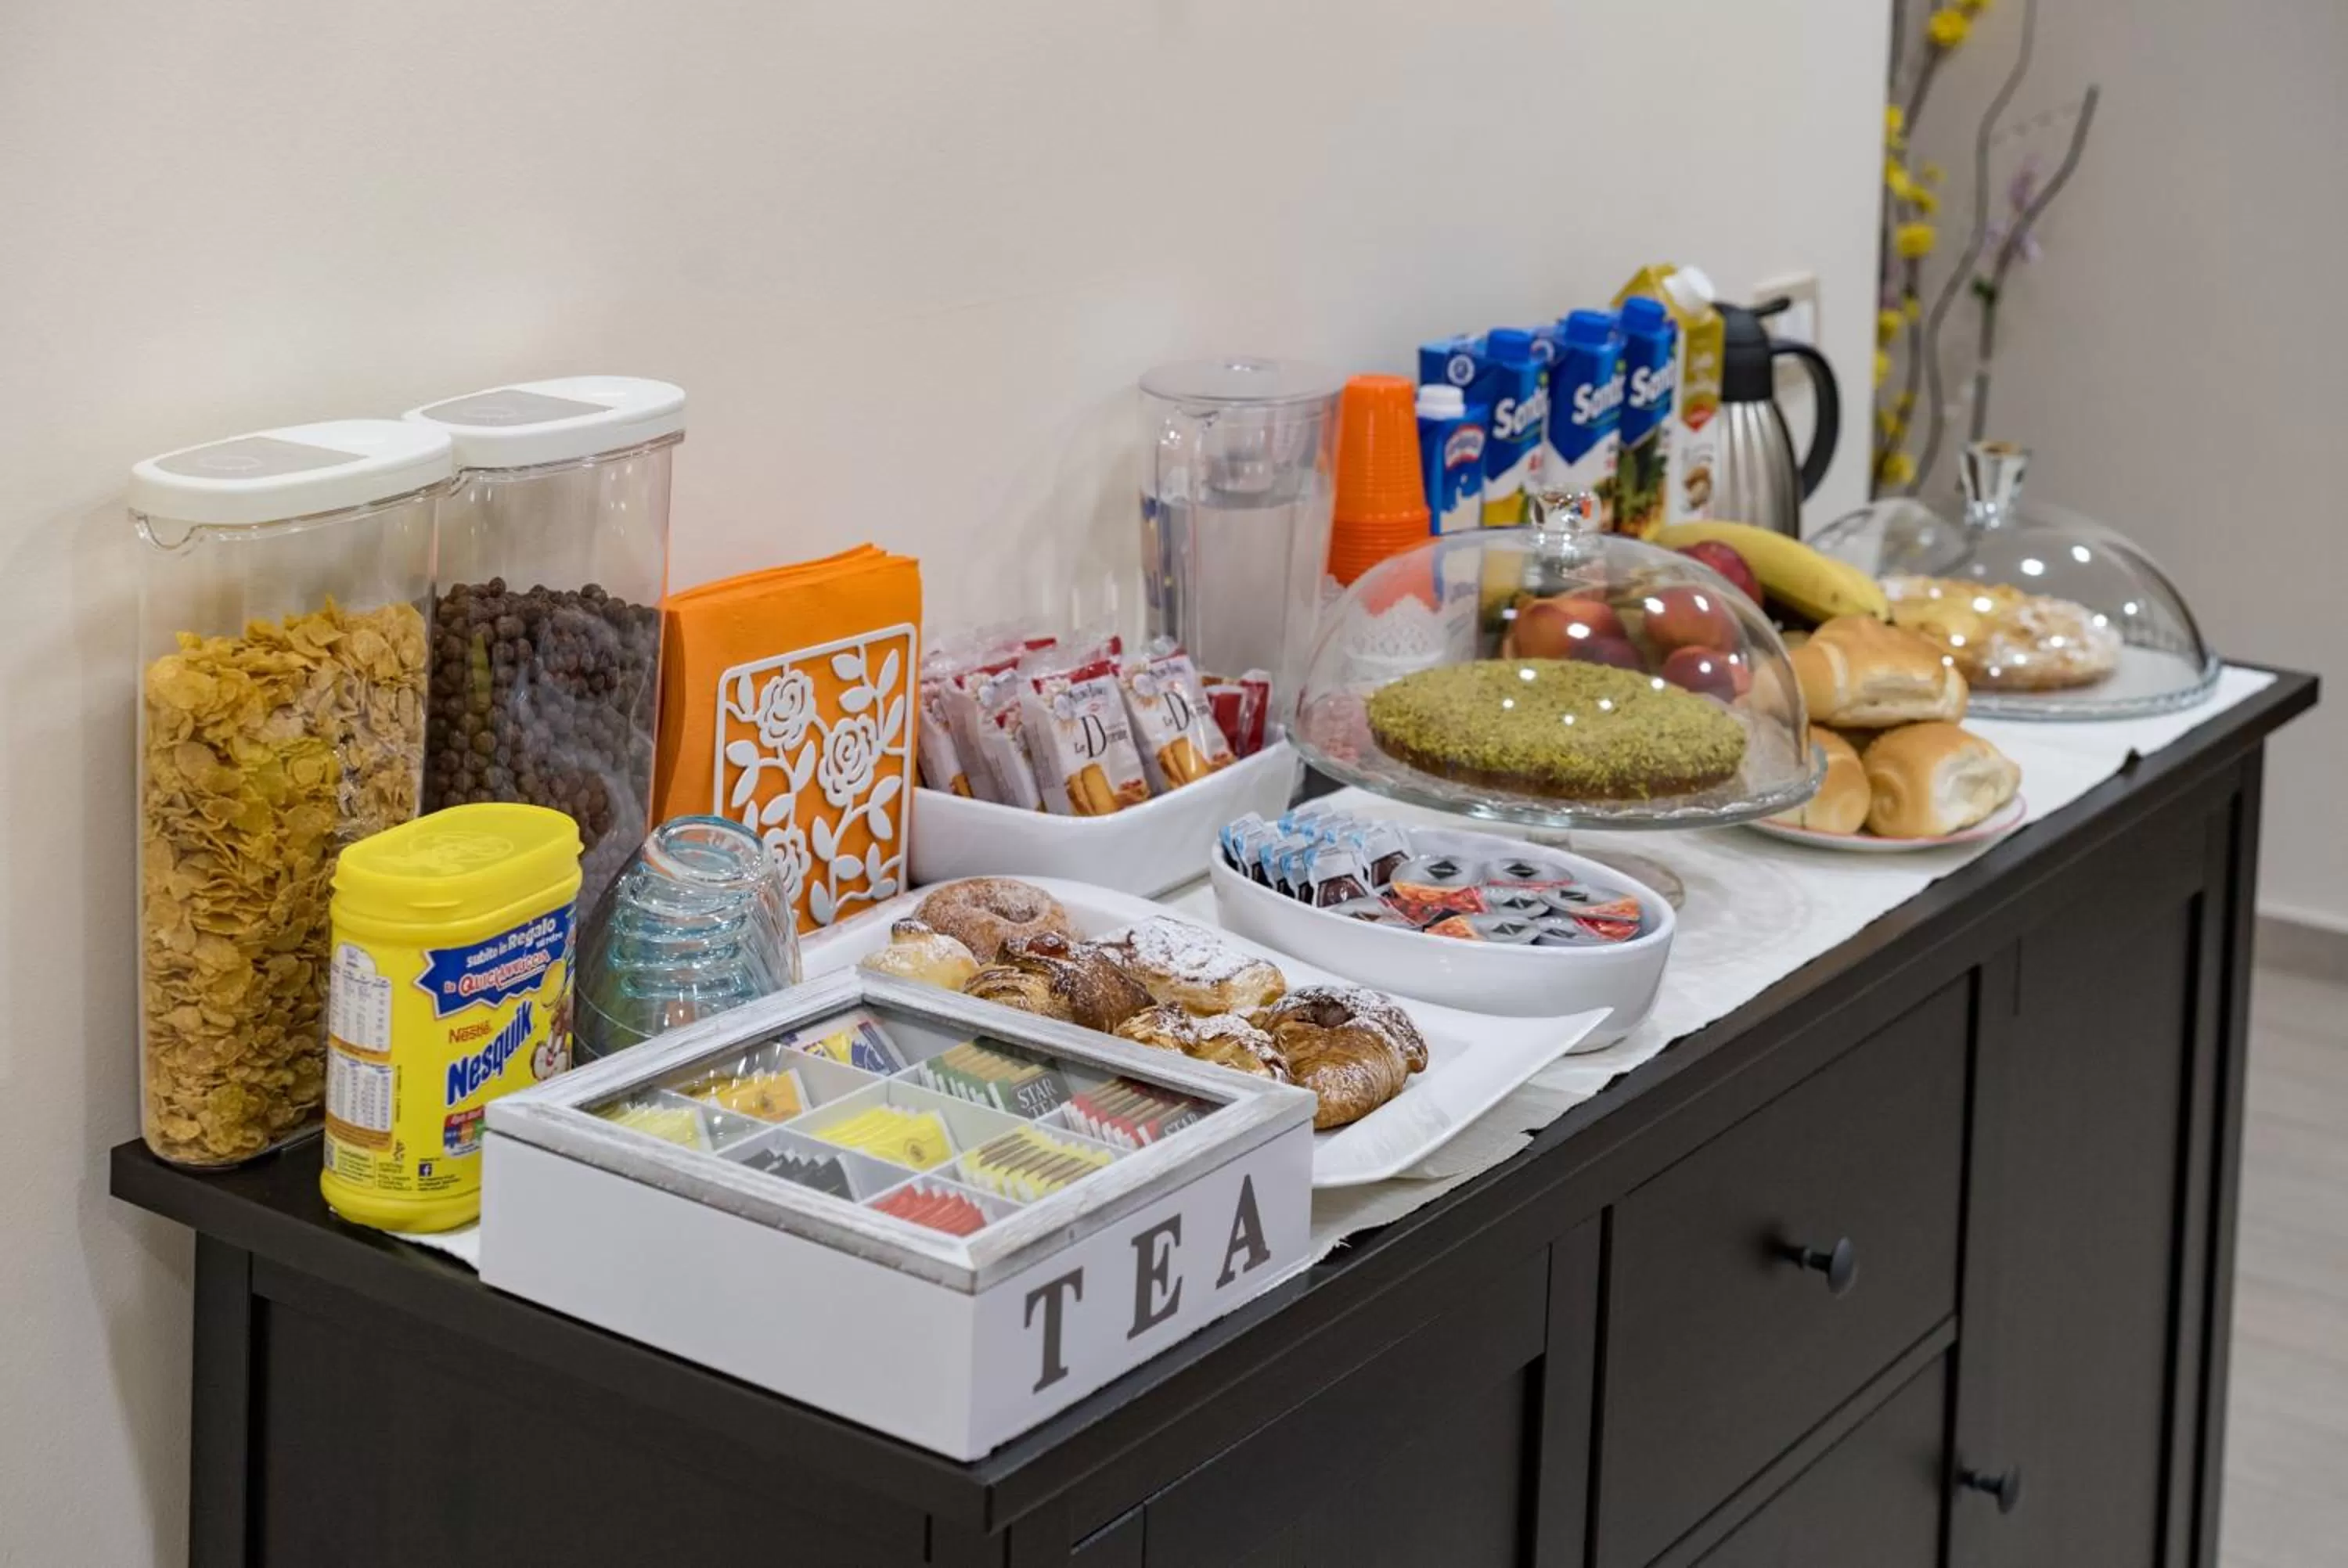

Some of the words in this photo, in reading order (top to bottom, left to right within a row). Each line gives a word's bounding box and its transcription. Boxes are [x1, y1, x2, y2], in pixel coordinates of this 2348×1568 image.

[508, 918, 556, 948] Regalo
[448, 1021, 492, 1043] Nestlé
[446, 1000, 534, 1107] Nesquik
[1017, 1077, 1058, 1109] STAR
[1023, 1173, 1272, 1395] TEA
